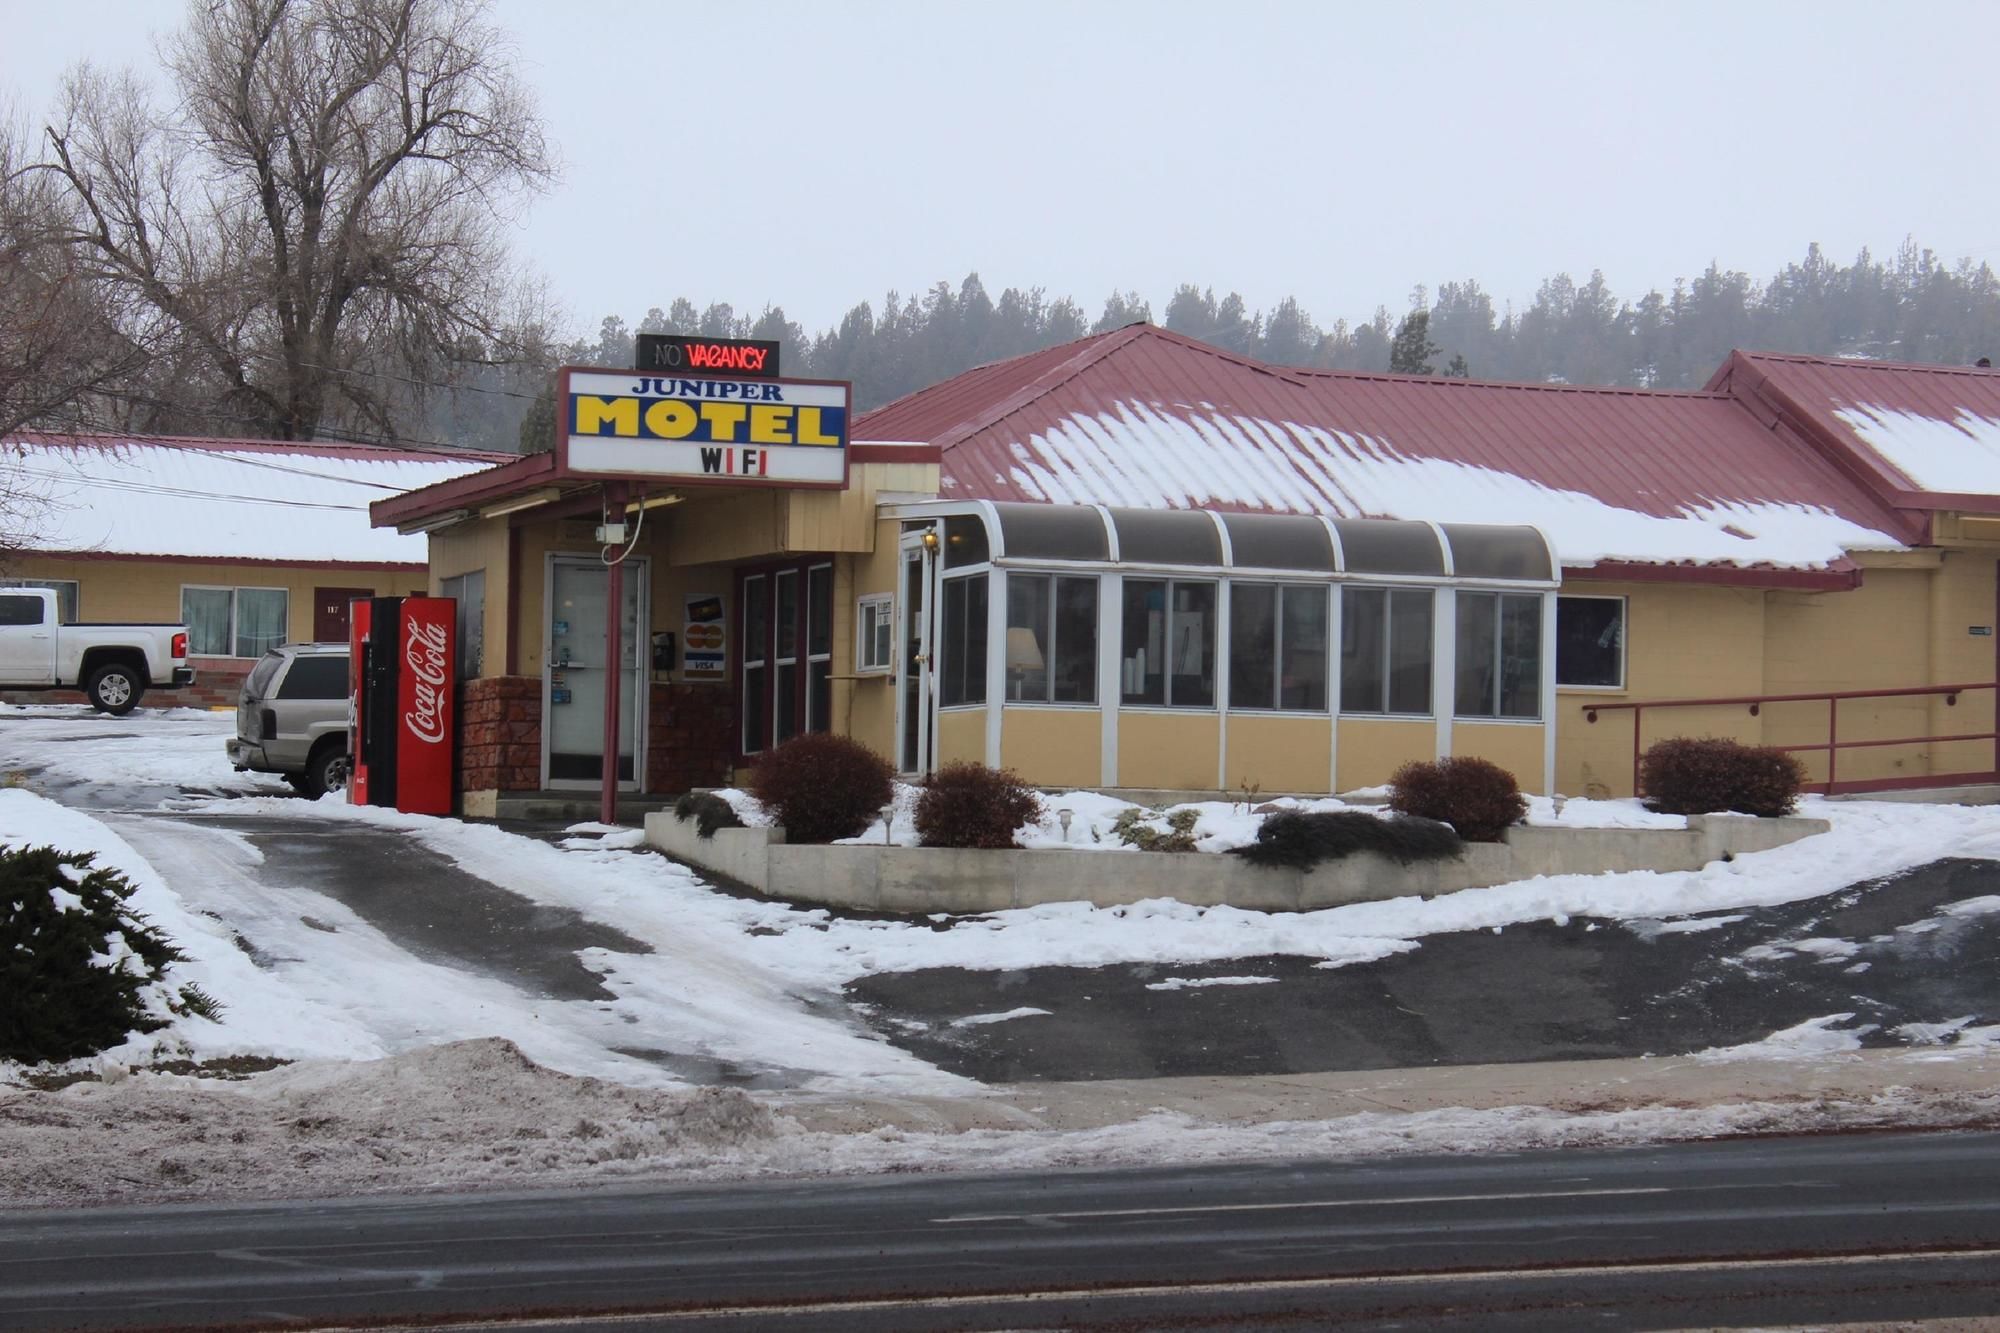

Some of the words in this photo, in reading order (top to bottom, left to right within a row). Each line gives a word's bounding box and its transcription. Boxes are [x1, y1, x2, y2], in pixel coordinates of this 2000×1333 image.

[655, 344, 681, 366] NO
[685, 343, 768, 370] VACANCY
[632, 378, 784, 401] JUNIPER
[576, 395, 839, 446] MOTEL
[695, 661, 714, 669] VISA
